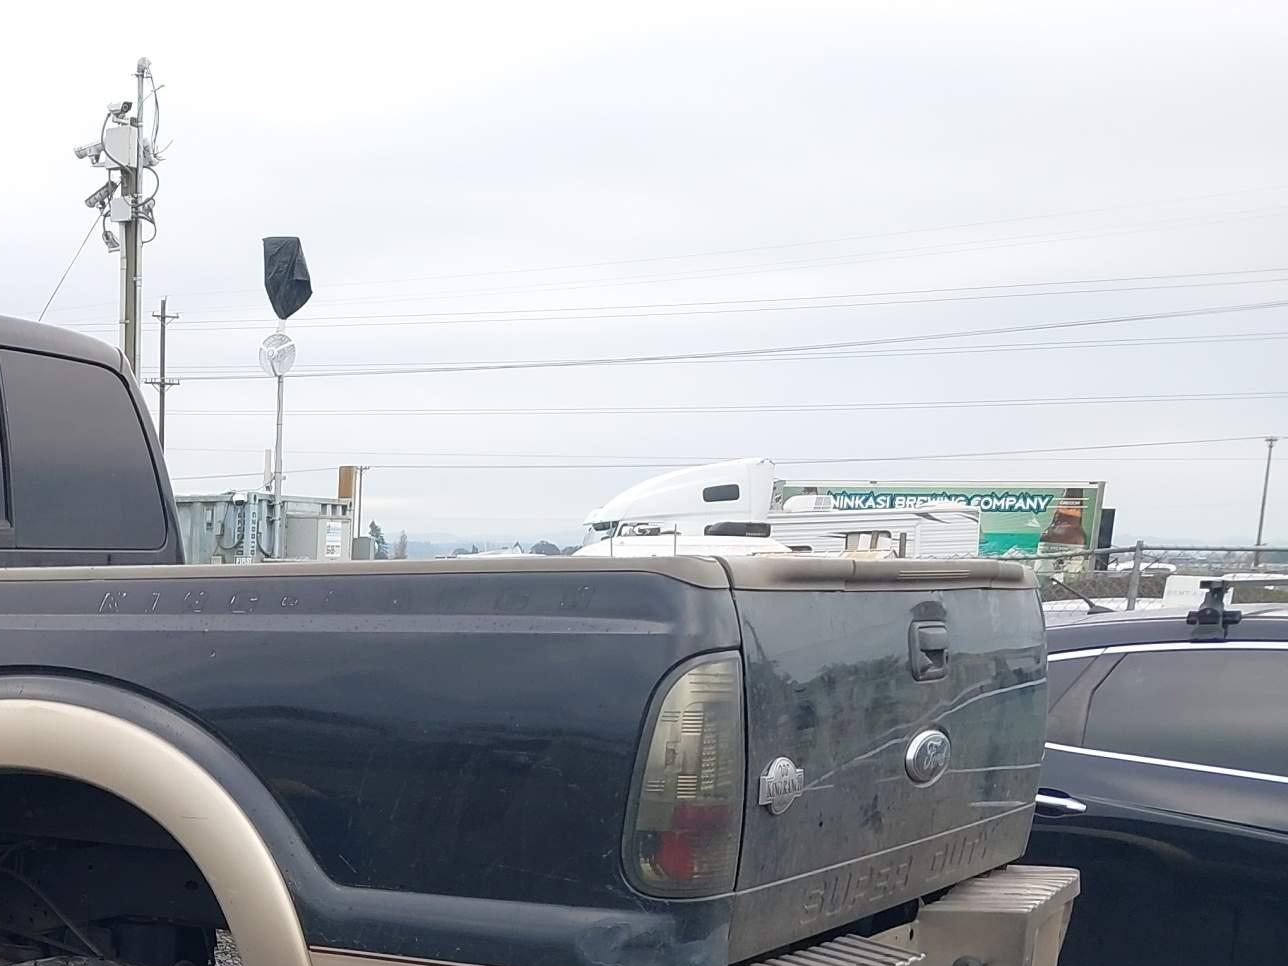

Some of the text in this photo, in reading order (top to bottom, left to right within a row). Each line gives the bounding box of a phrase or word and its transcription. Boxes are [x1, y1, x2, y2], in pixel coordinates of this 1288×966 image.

[830, 494, 891, 510] NINKASI
[970, 495, 1051, 511] COMPANY
[799, 827, 997, 925] SUPER DUTY
